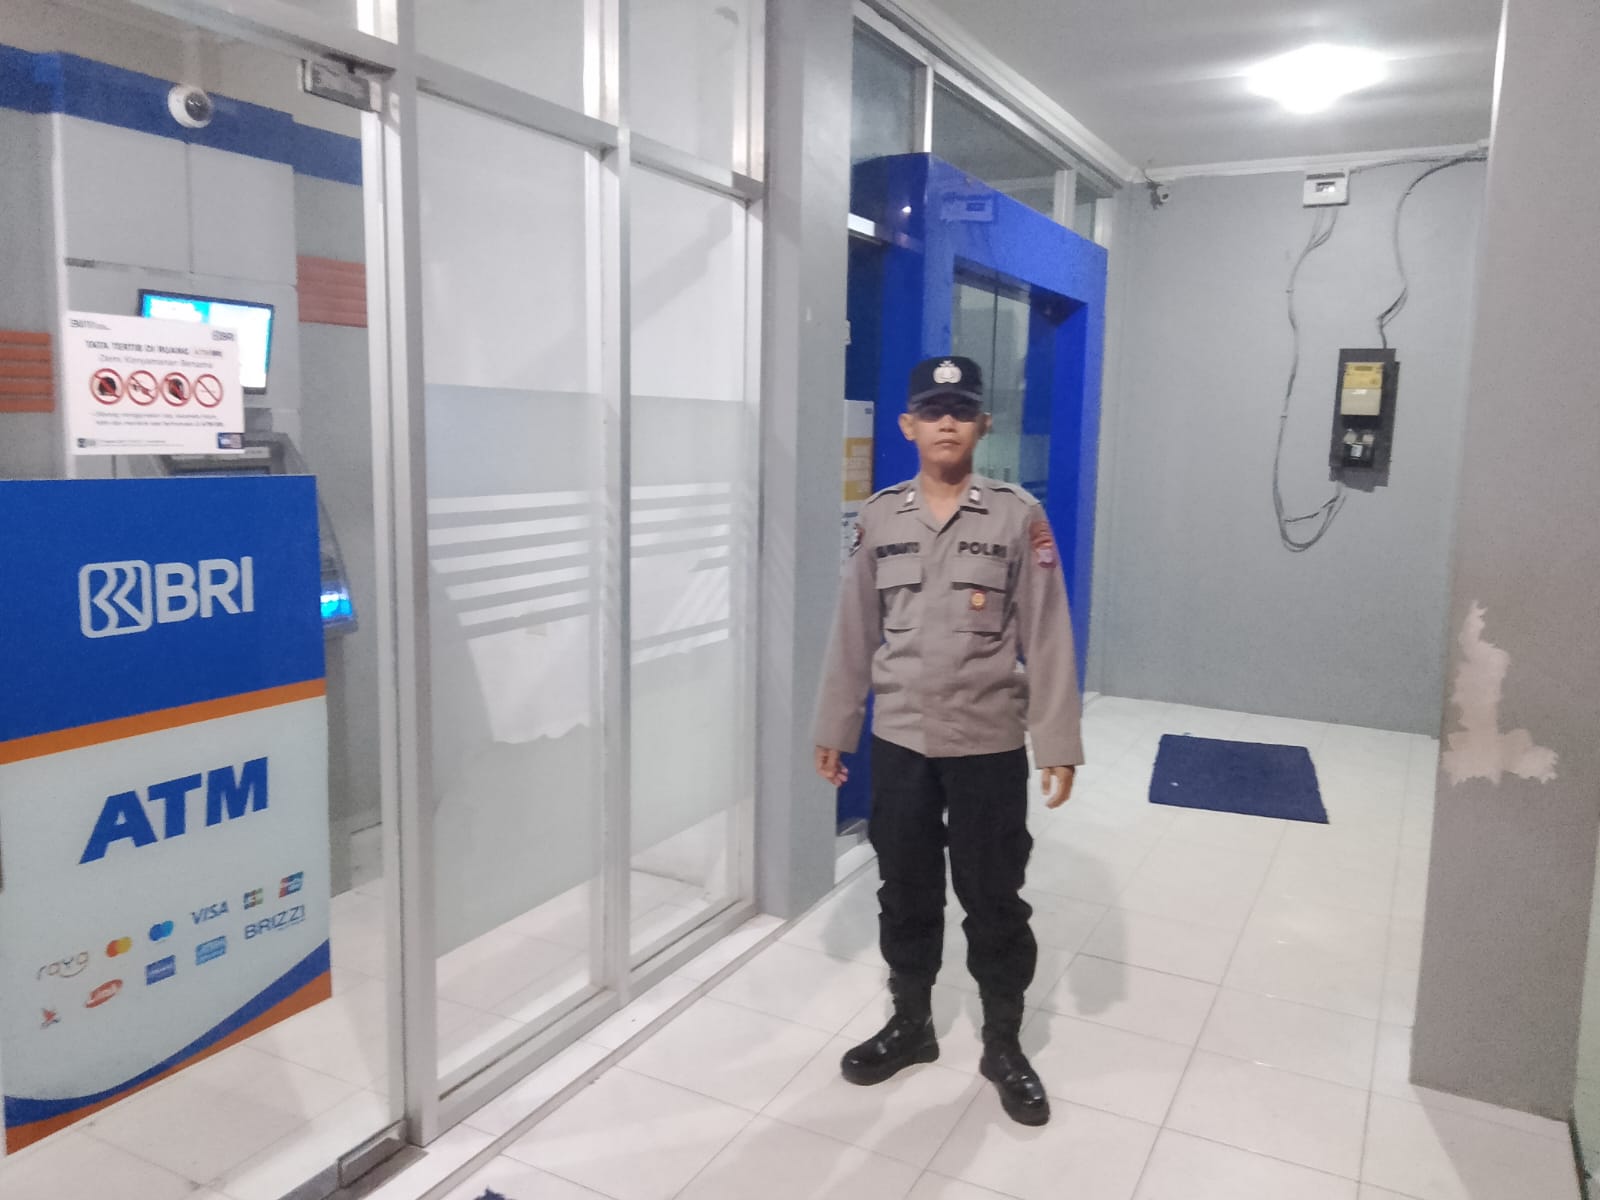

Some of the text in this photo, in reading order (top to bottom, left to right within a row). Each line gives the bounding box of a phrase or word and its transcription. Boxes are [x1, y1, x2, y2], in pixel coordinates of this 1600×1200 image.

[86, 340, 109, 349] TATA
[145, 344, 154, 353] DI
[155, 556, 254, 624] BRI
[79, 756, 269, 865] ATM
[191, 901, 228, 925] VISA
[244, 904, 306, 940] BRIZZI
